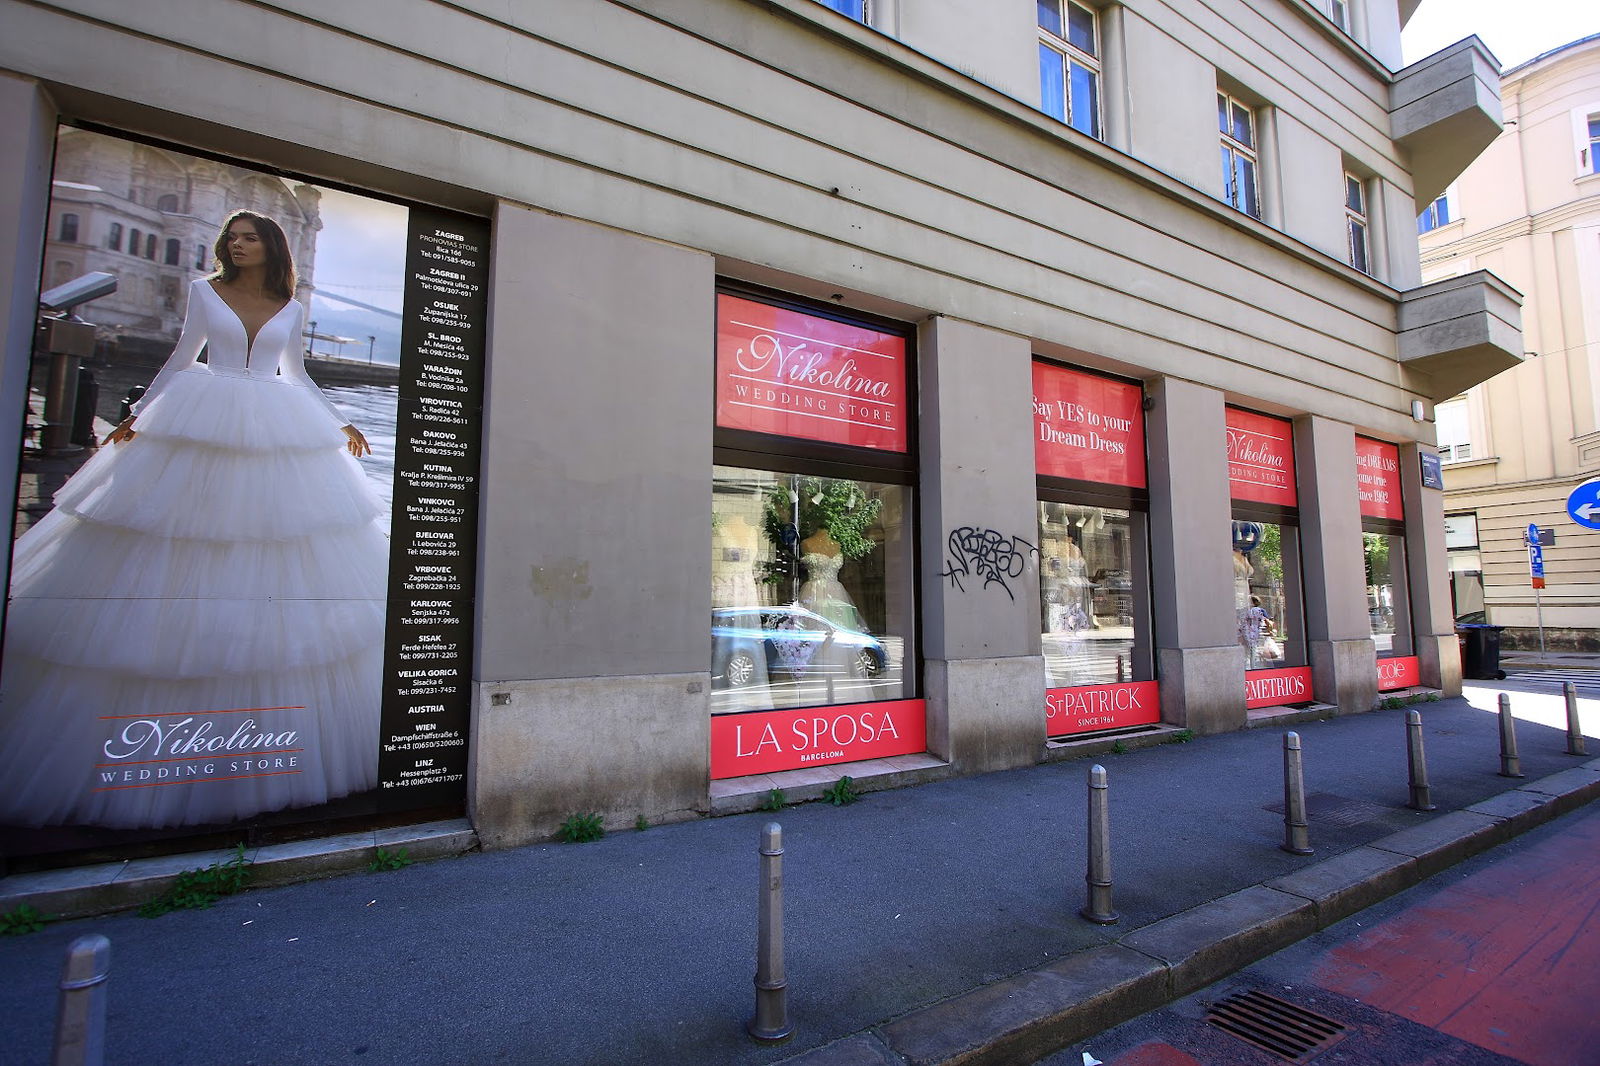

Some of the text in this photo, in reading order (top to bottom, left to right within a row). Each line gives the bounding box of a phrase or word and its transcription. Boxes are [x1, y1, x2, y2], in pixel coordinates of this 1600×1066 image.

[435, 229, 464, 241] ZAGREB
[420, 235, 478, 252] PRONOVIAS STORE
[421, 250, 432, 258] Tel:
[430, 268, 459, 279] ZAGREB
[433, 301, 459, 311] OSIJEK
[419, 314, 430, 322] Tel:
[440, 334, 461, 343] BROD
[423, 364, 462, 375] VARAŽDIN
[736, 334, 890, 398] Nikolina
[428, 373, 454, 382] Vodnika
[420, 397, 462, 408] VIROVITICA
[735, 384, 892, 422] WEDDING STORE
[1032, 396, 1132, 432] Say YES to your
[423, 430, 456, 440] ĐAKOVO
[1040, 422, 1124, 455] Dream Dress
[410, 437, 427, 445] Bana
[1226, 430, 1283, 466] Nikolina
[1367, 454, 1396, 472] DREAMS
[423, 464, 453, 473] KUTINA
[400, 471, 419, 480] Kralja
[1228, 467, 1285, 483] DDING STORE
[1357, 474, 1372, 484] ome
[418, 497, 455, 506] VINKOVCI
[415, 531, 454, 539] BJELOVAR
[1531, 547, 1537, 563] P
[411, 609, 437, 617] Senjska
[401, 617, 413, 625] Tel:
[427, 669, 457, 677] GORICA
[1377, 660, 1405, 679] icole
[410, 686, 457, 695] 099/231-7452
[408, 704, 445, 714] AUSTRIA
[1078, 715, 1114, 727] SINCE 1964
[415, 723, 436, 731] WIEN
[104, 717, 299, 759] Nikolina
[736, 711, 899, 757] LA SPOSA
[384, 744, 396, 752] Tel:
[800, 750, 844, 762] BARCELONA
[415, 759, 434, 767] LINZ
[101, 756, 298, 783] WEDDING STORE
[400, 768, 441, 777] Hessenplatz
